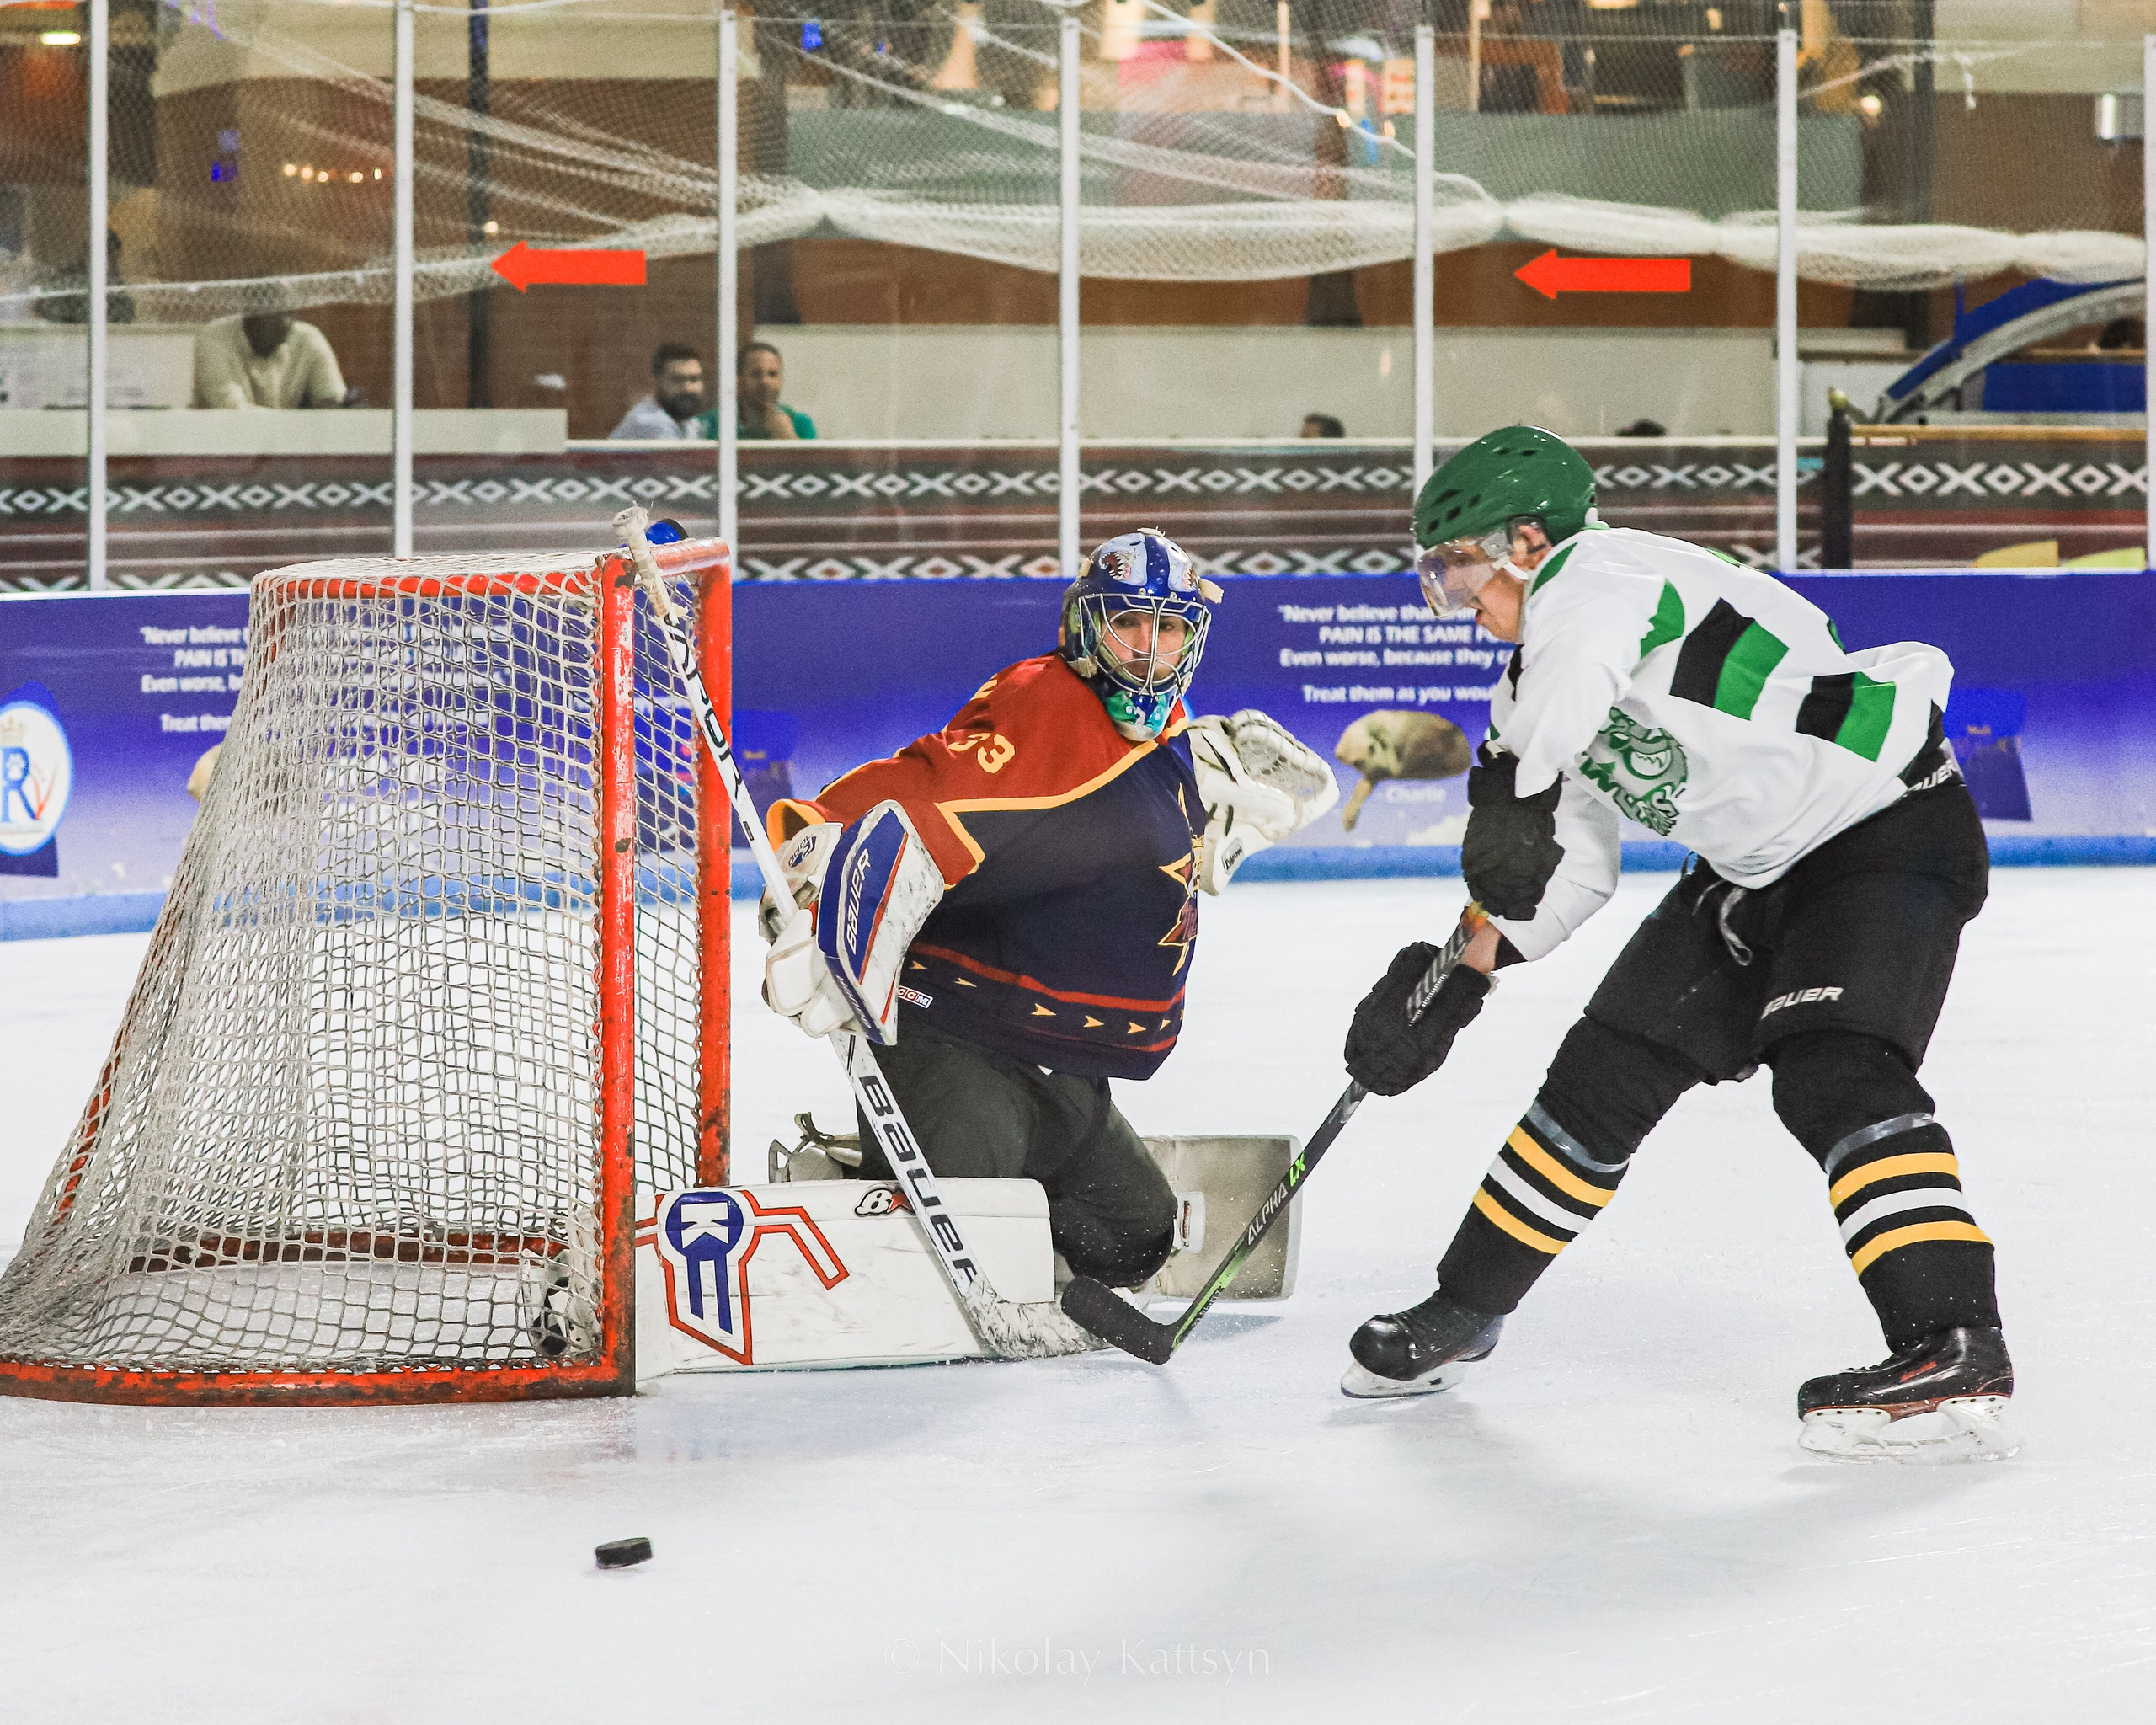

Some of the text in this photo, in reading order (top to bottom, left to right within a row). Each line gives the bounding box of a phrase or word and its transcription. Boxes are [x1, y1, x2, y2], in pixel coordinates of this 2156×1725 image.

[1319, 626, 1364, 644] PAIN
[1365, 625, 1382, 644] IS
[1385, 625, 1421, 644] THE
[1422, 625, 1473, 644] SAME
[1417, 686, 1452, 706] you
[897, 987, 931, 1007] CCM
[1247, 1182, 1289, 1246] ALPHA
